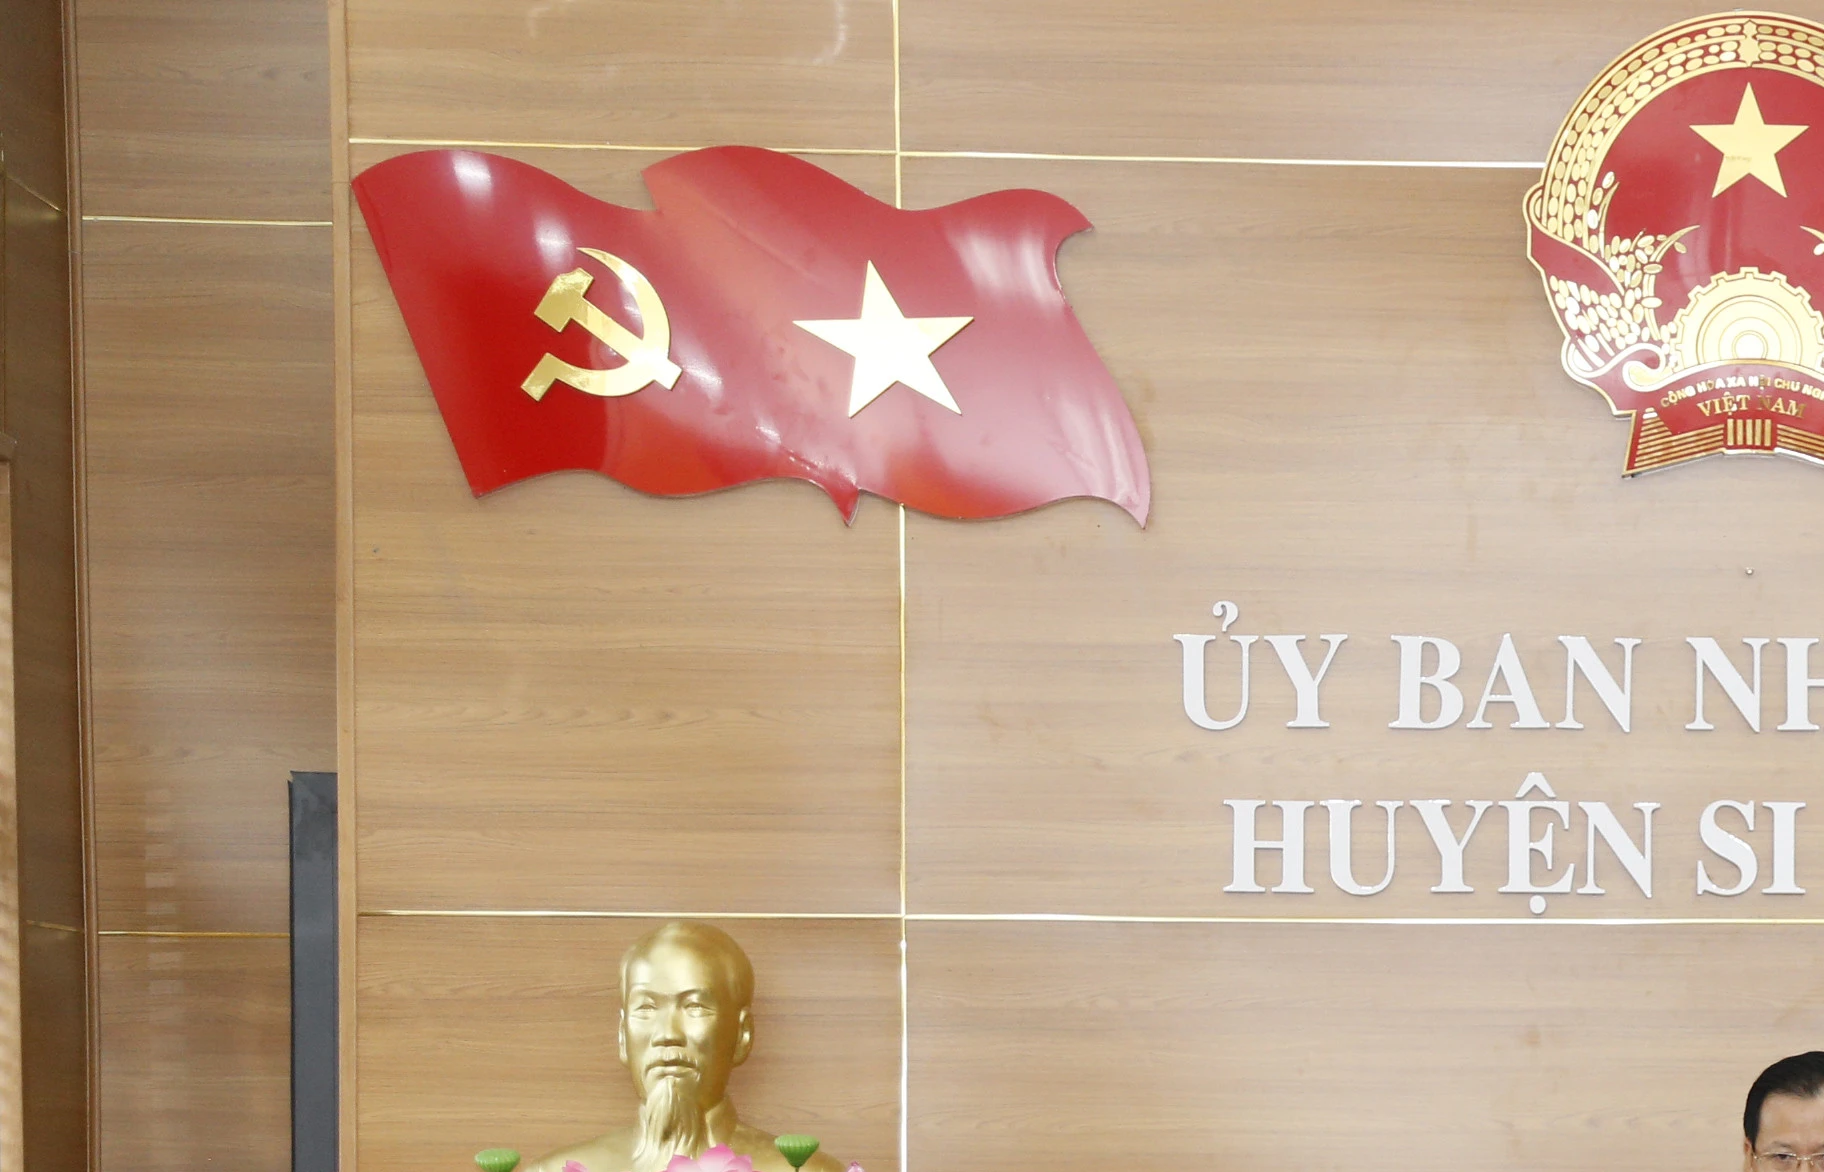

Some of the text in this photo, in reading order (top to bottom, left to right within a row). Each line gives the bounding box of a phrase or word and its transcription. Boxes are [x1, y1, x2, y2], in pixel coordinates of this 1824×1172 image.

[1696, 391, 1807, 419] VIỆT NAM
[1172, 599, 1349, 732] ỦY
[1387, 631, 1643, 733] BAN
[1222, 770, 1662, 916] HUYỆN
[1696, 798, 1807, 896] SI
